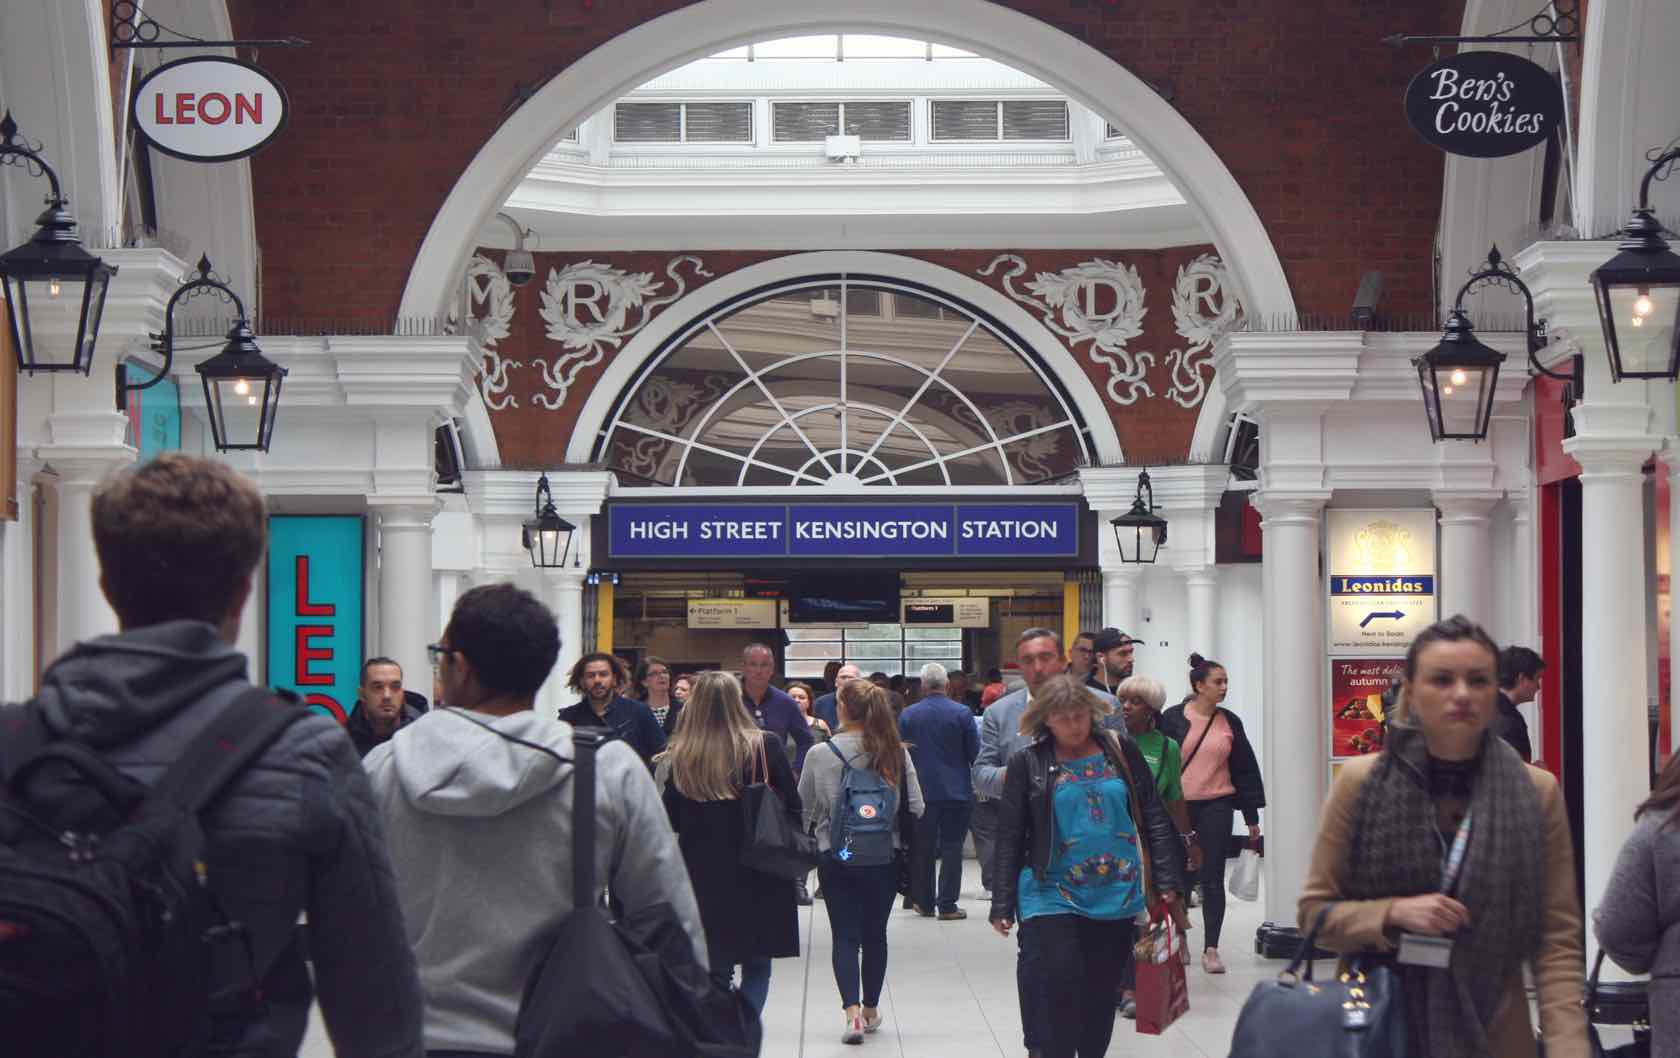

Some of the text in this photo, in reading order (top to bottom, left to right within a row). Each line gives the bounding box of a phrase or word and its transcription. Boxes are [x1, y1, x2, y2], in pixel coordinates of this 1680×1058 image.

[1429, 68, 1515, 101] Ben's
[155, 92, 263, 125] LEON
[1435, 100, 1544, 134] Cookies
[563, 279, 606, 328] R
[1080, 279, 1126, 321] D
[1185, 272, 1222, 317] R
[630, 520, 1058, 539] HIGH STREET KENSINGTON STATION
[1342, 578, 1424, 593] Leonidas
[1341, 664, 1358, 675] The
[1360, 667, 1380, 675] most
[1350, 678, 1388, 686] autumn
